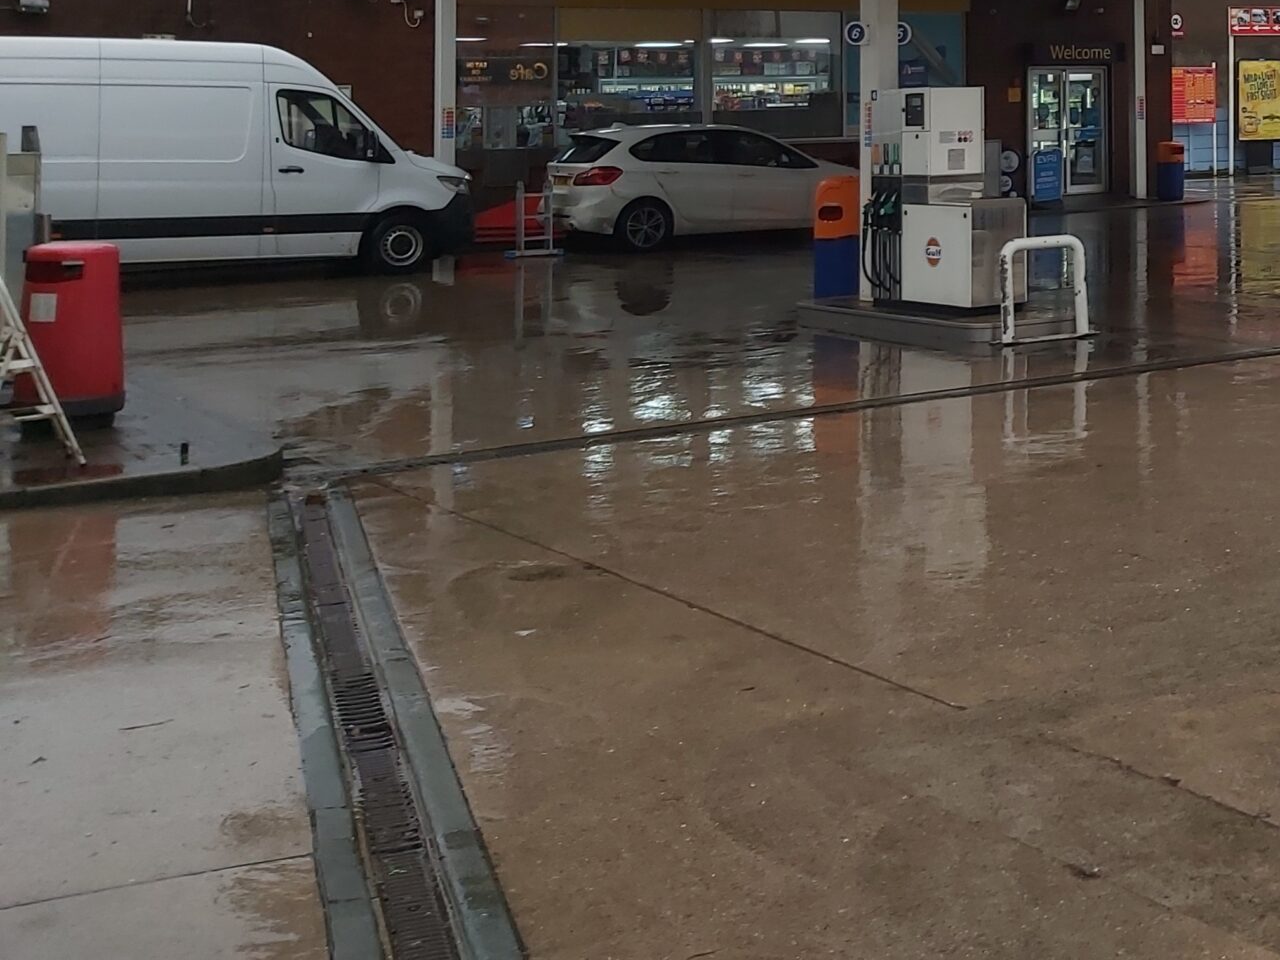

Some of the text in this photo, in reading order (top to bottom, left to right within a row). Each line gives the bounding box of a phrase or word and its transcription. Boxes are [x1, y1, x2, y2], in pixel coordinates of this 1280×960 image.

[851, 27, 862, 40] 6
[1050, 44, 1112, 60] Welcome
[925, 247, 942, 257] Gulf
